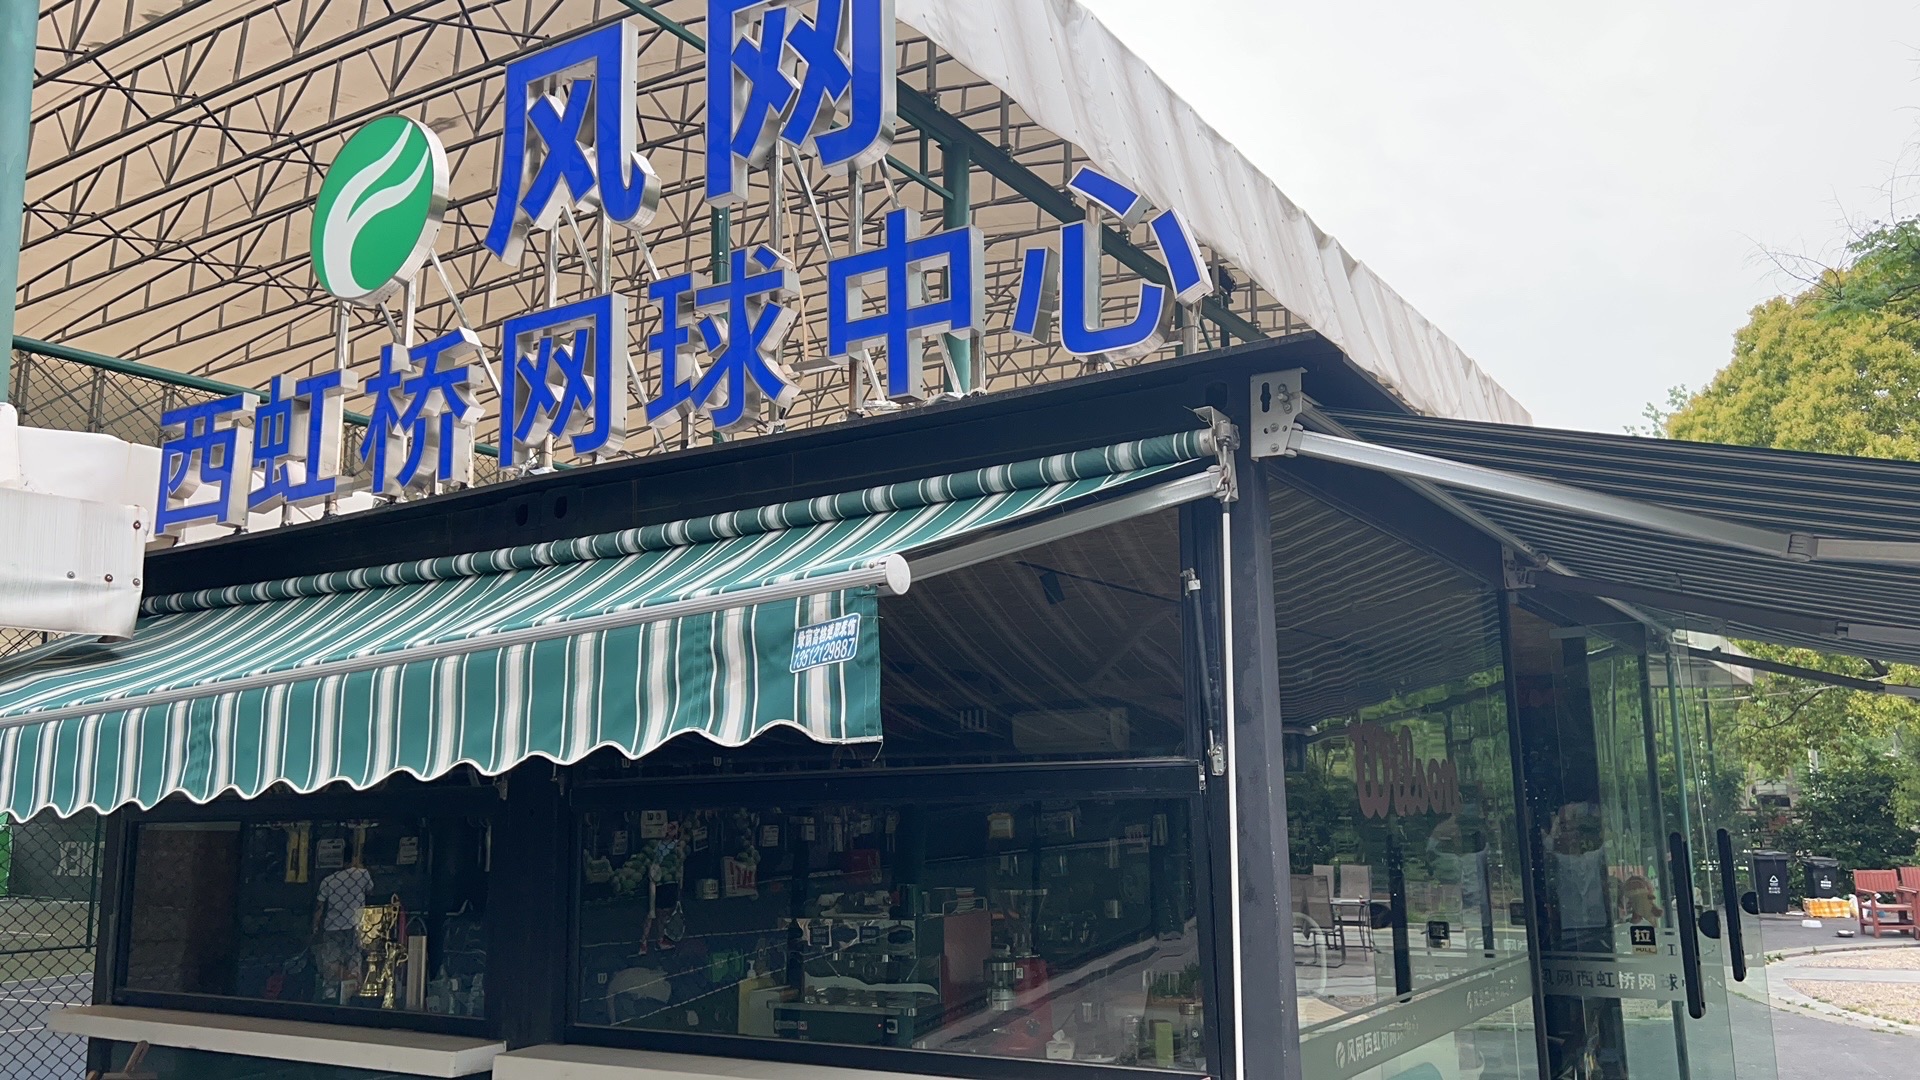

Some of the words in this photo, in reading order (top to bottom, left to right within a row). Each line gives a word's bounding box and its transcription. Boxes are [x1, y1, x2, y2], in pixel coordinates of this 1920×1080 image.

[483, 0, 890, 262] 风网
[155, 165, 1205, 536] 西虹桥网球中心
[1349, 722, 1461, 819] Wilson
[1634, 929, 1651, 942] 拉
